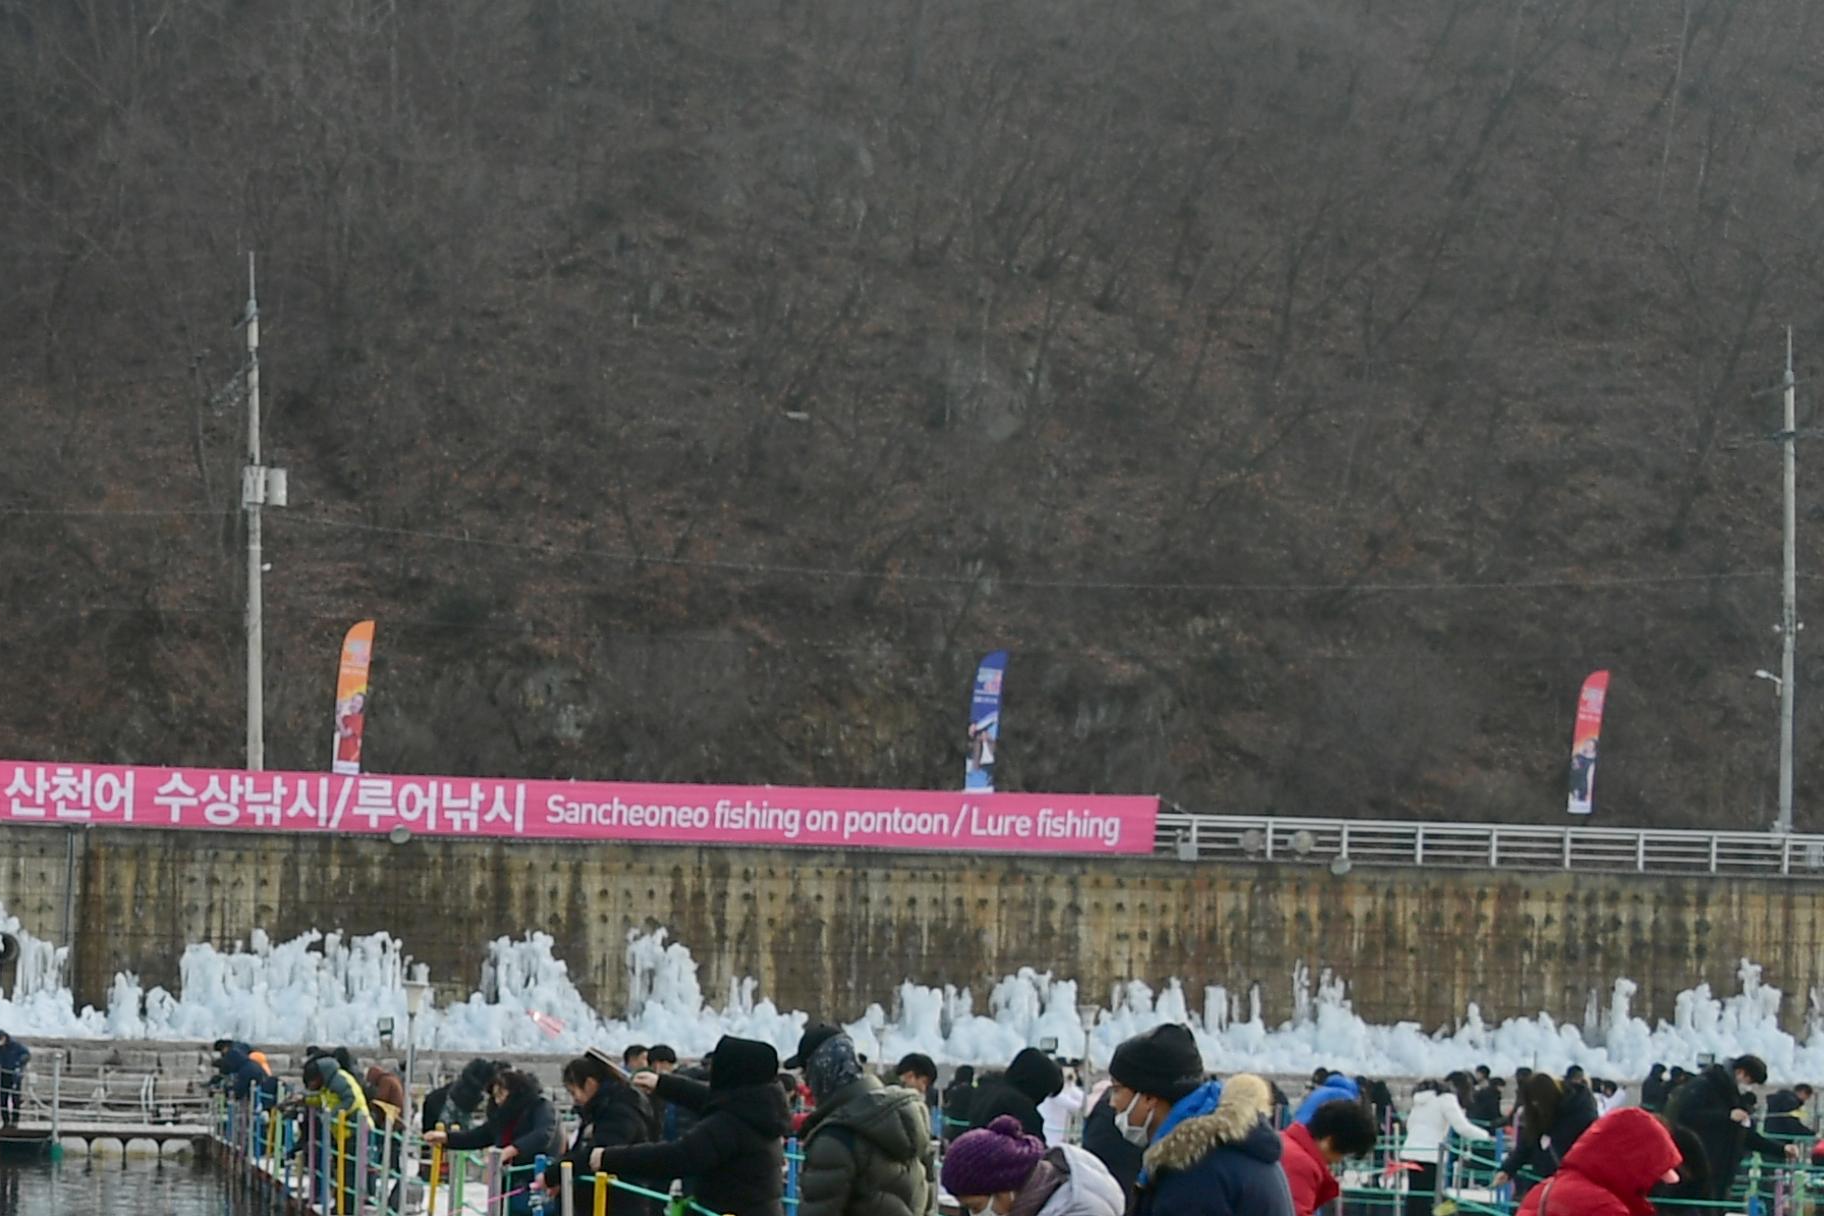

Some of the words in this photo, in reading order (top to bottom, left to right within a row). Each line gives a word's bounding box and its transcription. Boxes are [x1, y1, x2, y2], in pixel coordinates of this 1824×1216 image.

[4, 766, 136, 822] 산천어
[153, 771, 527, 833] 수상낚시/루어낚시
[547, 794, 710, 828] Sancheoneo
[716, 799, 801, 838] fishing
[805, 810, 839, 832] on
[843, 807, 949, 839] pontoon
[1037, 809, 1122, 846] fishing
